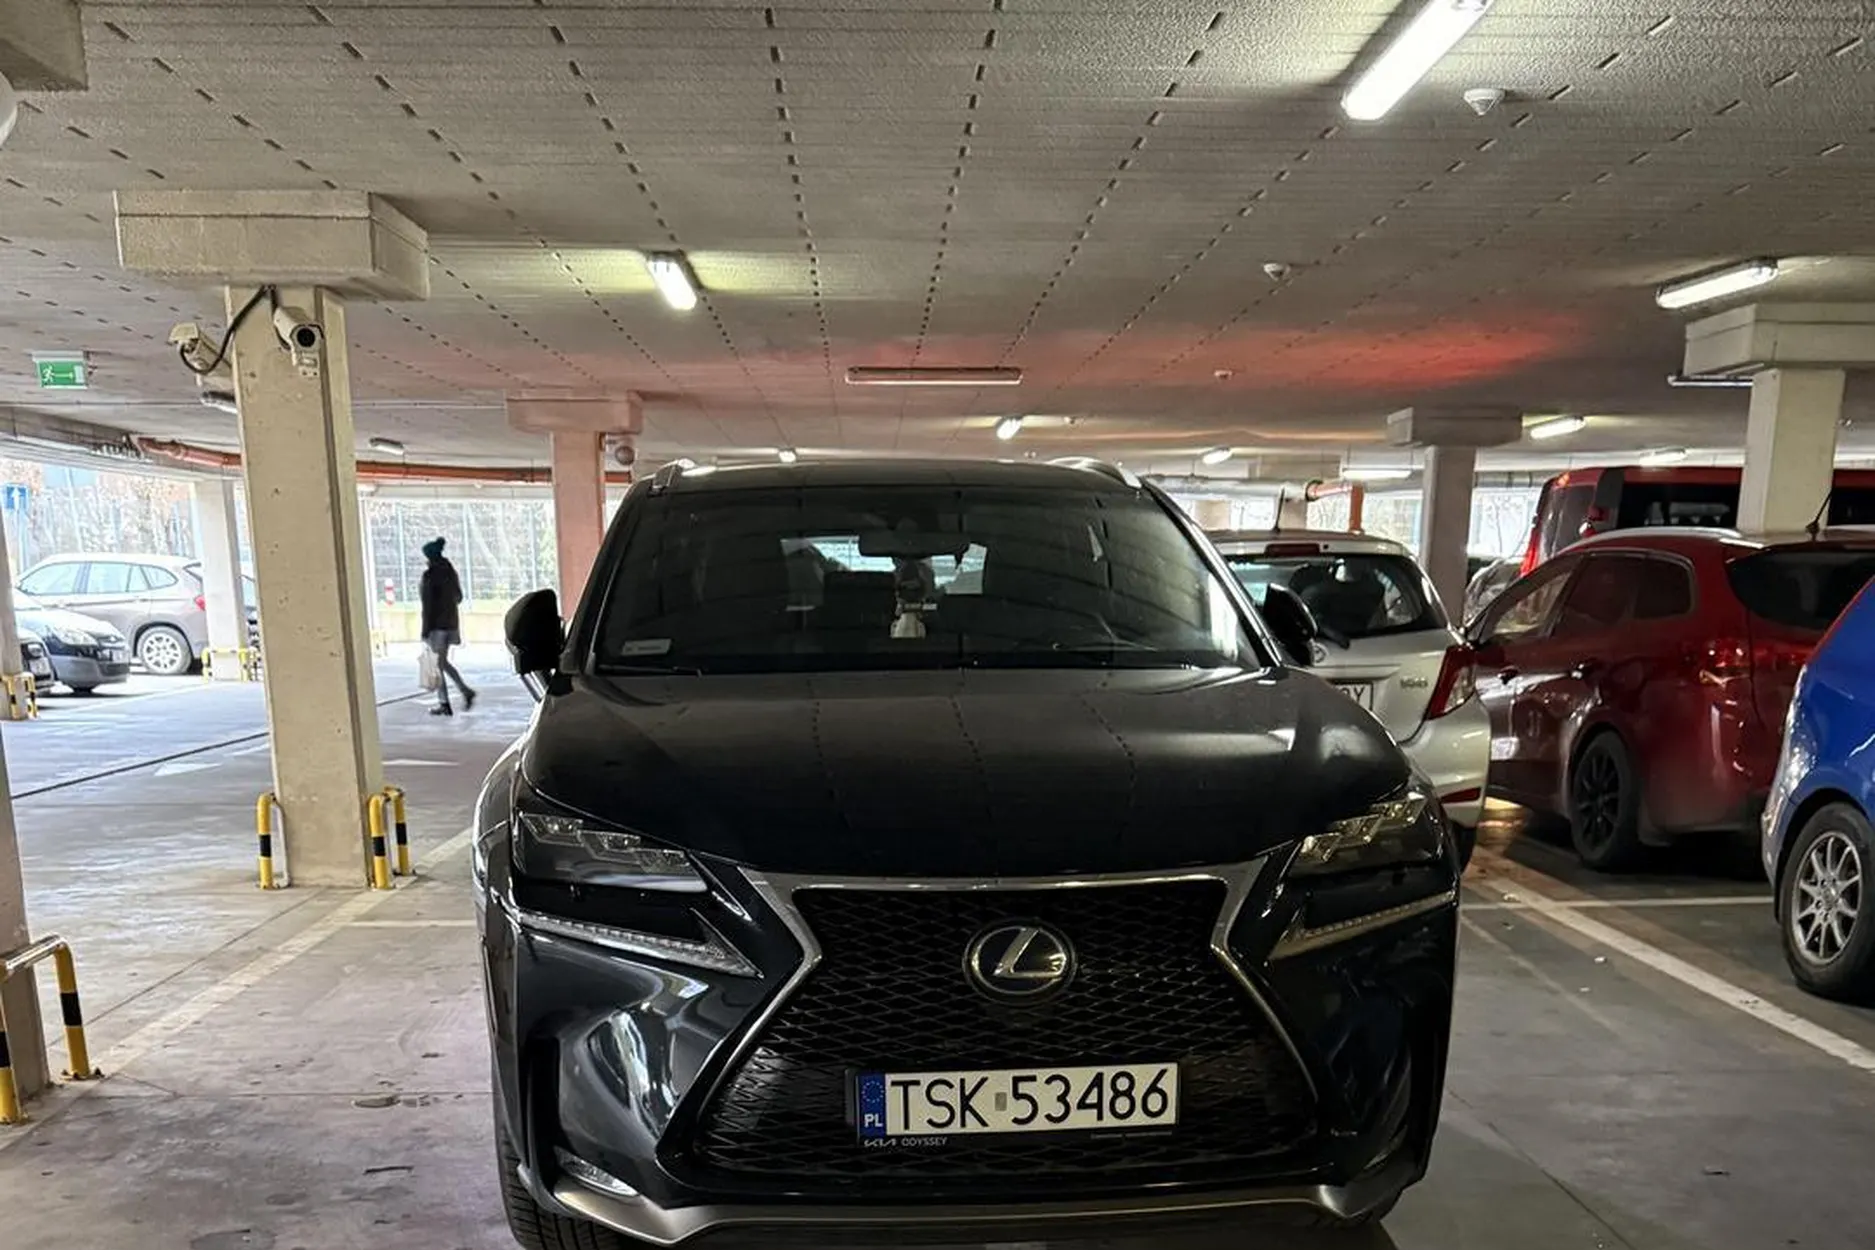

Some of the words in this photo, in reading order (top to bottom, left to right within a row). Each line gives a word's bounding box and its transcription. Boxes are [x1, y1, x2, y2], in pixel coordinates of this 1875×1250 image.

[890, 1076, 989, 1130] TSK
[1011, 1068, 1169, 1125] 53486
[864, 1113, 883, 1128] PL
[901, 1136, 948, 1147] ODYSSEY
